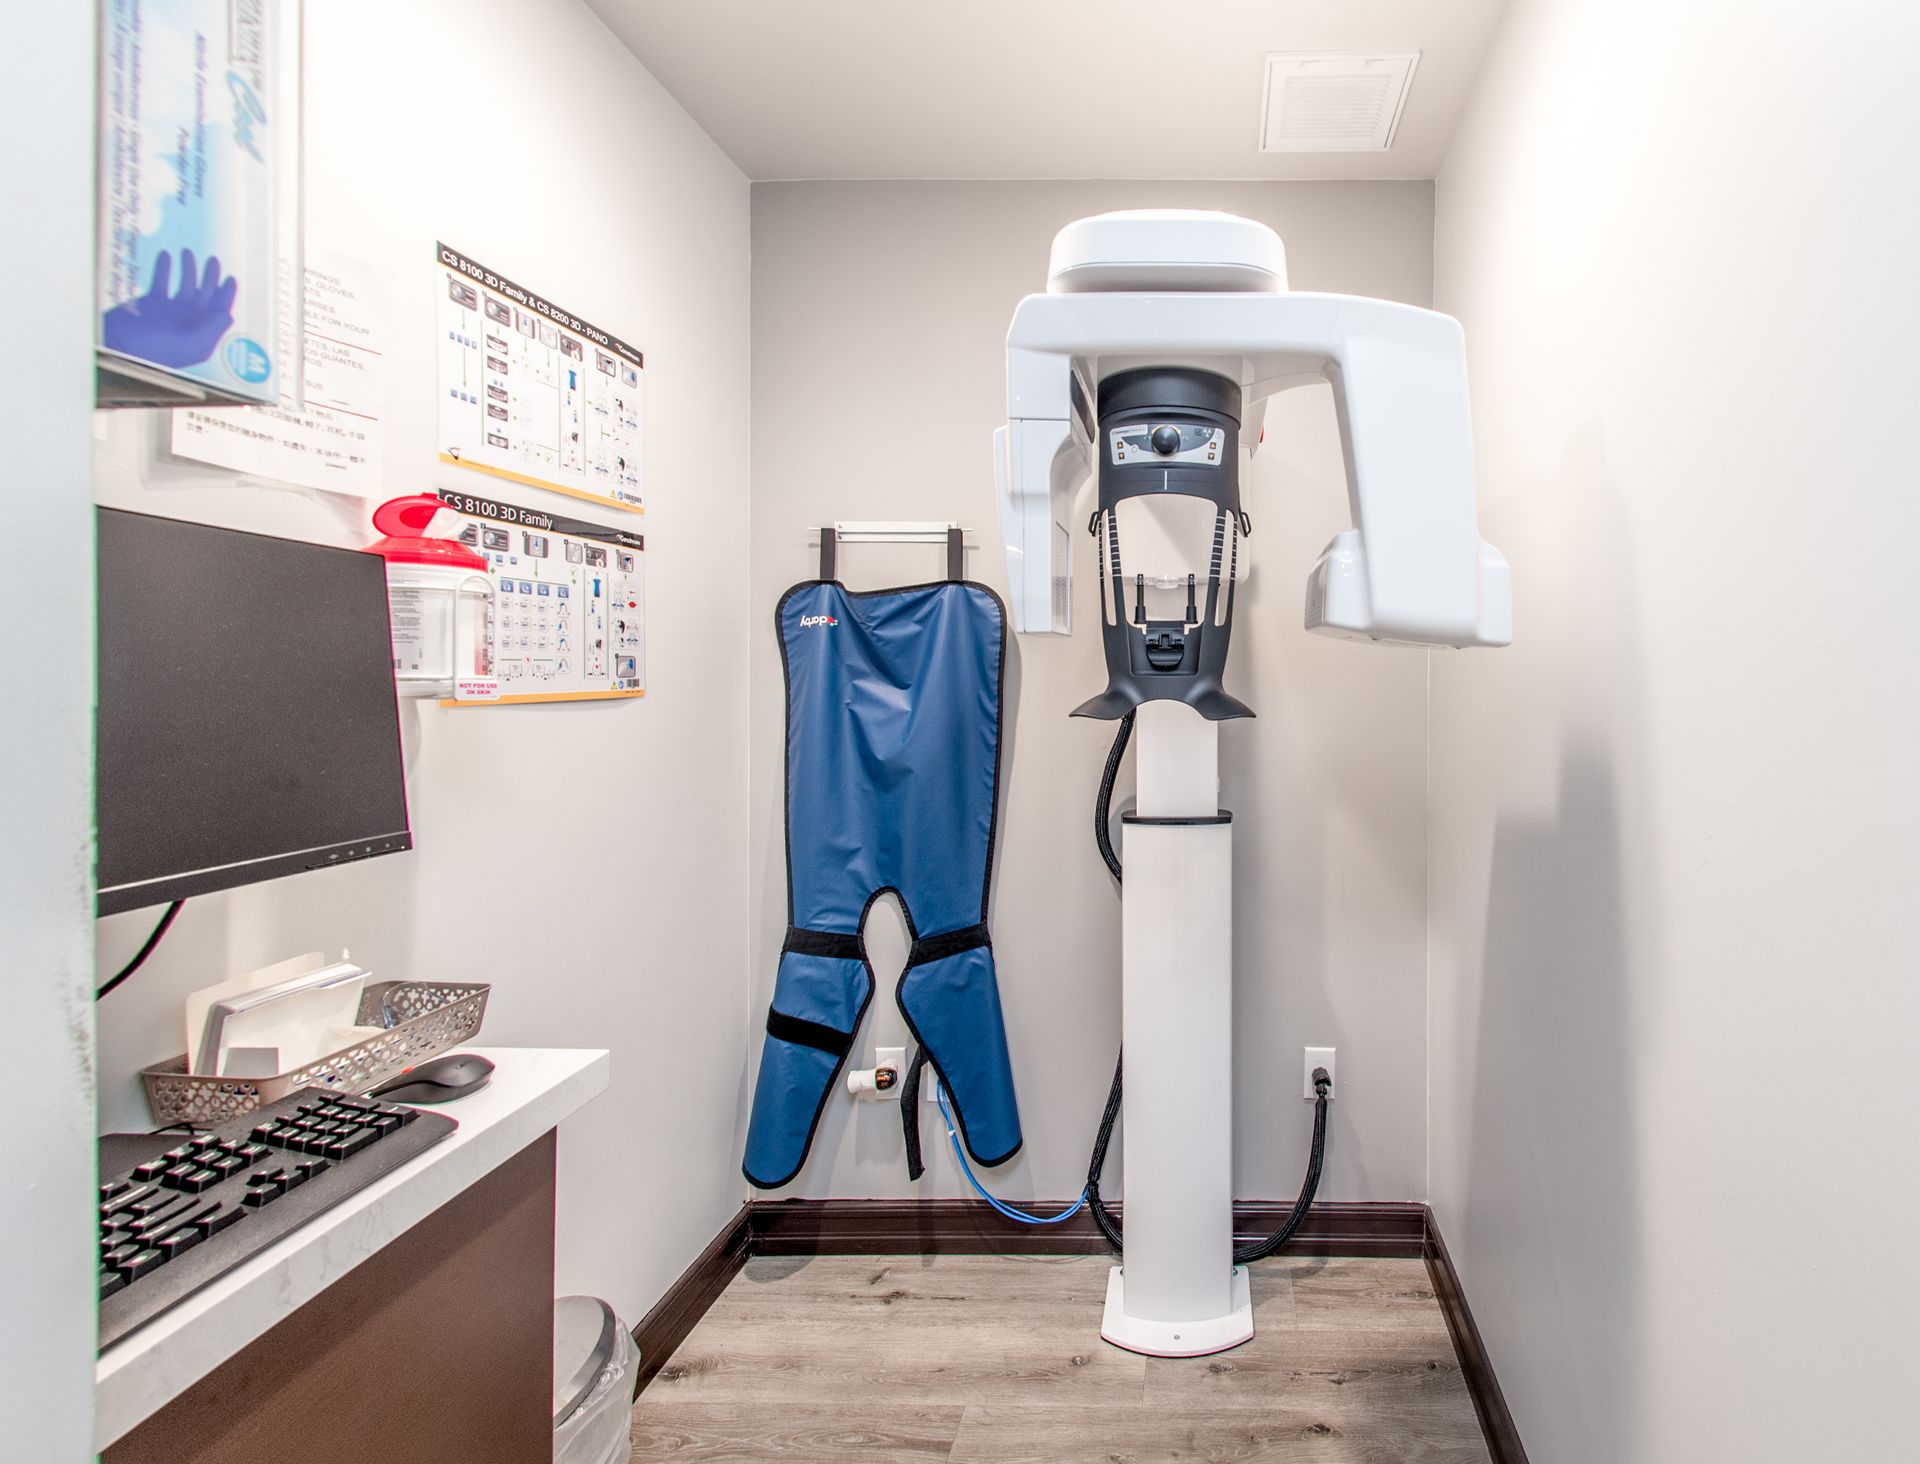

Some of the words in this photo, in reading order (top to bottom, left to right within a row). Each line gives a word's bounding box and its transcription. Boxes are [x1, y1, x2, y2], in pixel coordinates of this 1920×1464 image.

[177, 126, 190, 175] Powder
[175, 177, 190, 206] Free
[193, 154, 208, 198] Gloves
[441, 250, 458, 268] CS
[459, 259, 484, 281] 8100
[485, 273, 499, 288] 3D
[499, 280, 528, 305] Family
[528, 297, 536, 308] &
[536, 301, 550, 315] CS
[550, 308, 570, 326] 8200
[570, 318, 581, 333] 3D
[586, 327, 609, 346] PANO
[248, 352, 267, 375] M
[444, 493, 462, 510] CS
[465, 498, 498, 517] 8100
[500, 506, 518, 522] 3D
[519, 510, 553, 531] Family
[799, 615, 828, 628] darby
